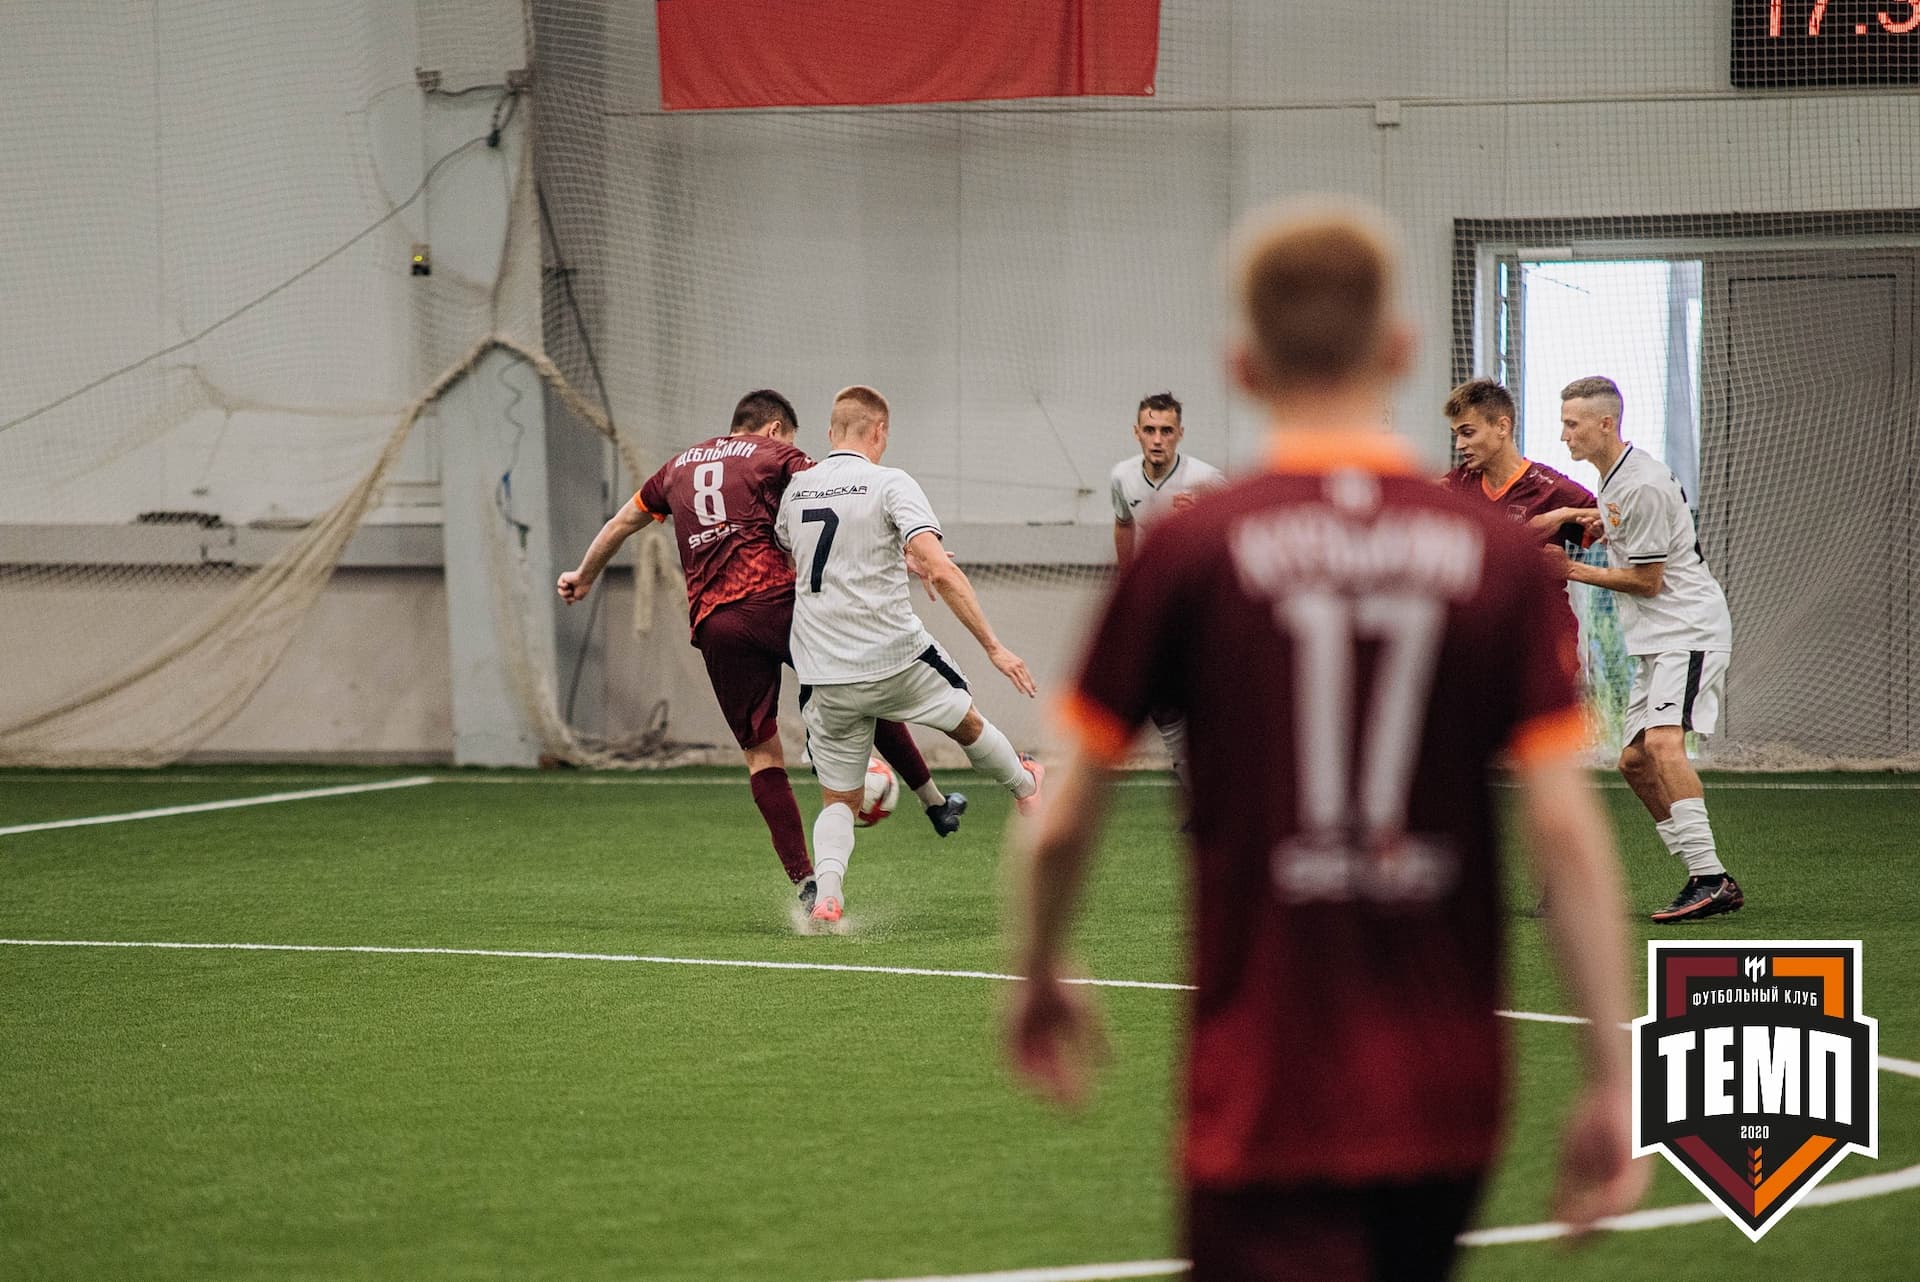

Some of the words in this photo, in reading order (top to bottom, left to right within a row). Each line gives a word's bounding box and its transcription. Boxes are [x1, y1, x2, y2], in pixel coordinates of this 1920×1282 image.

[694, 461, 727, 526] 8
[801, 507, 839, 593] 7
[1276, 593, 1446, 832] 17
